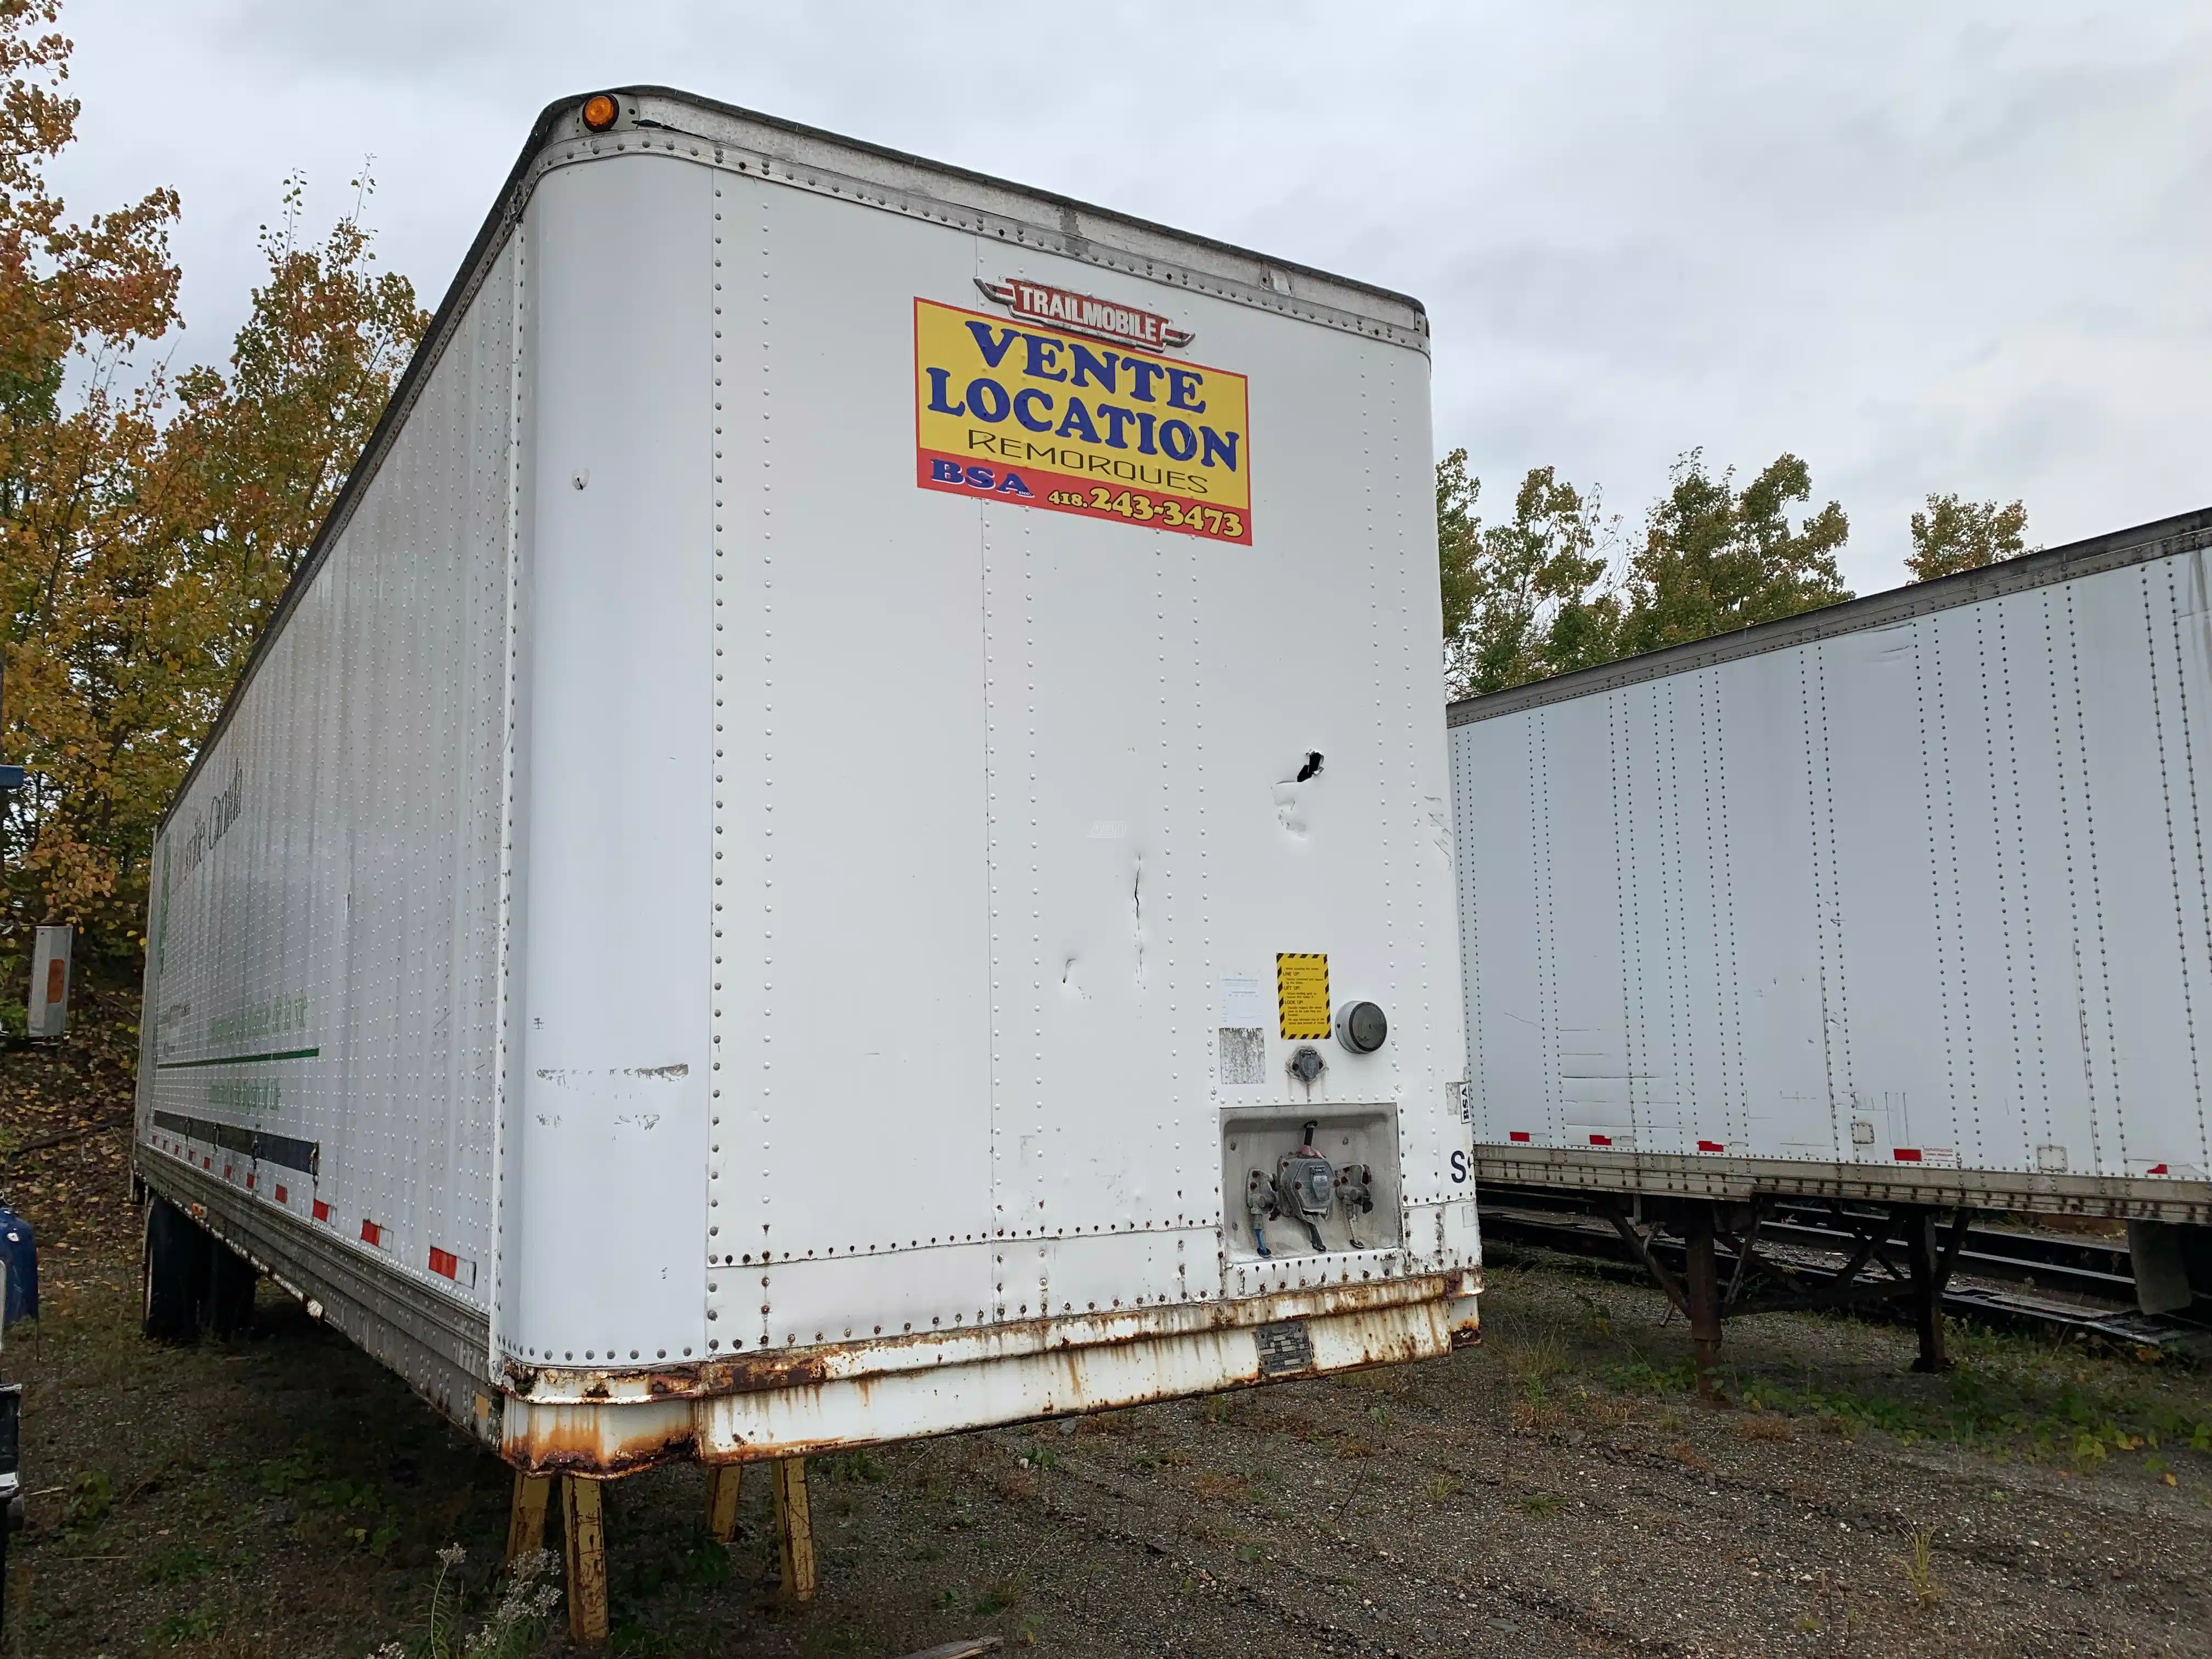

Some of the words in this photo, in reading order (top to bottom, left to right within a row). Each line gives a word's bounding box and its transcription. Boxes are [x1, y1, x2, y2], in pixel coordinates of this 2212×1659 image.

[1020, 286, 1157, 341] TRAILMOBILE
[965, 320, 1206, 414] VENTE
[927, 368, 1240, 472] LOCATION
[930, 459, 1035, 498] BSA
[968, 430, 1208, 493] REMORQUES
[1462, 1085, 1470, 1120] BSA
